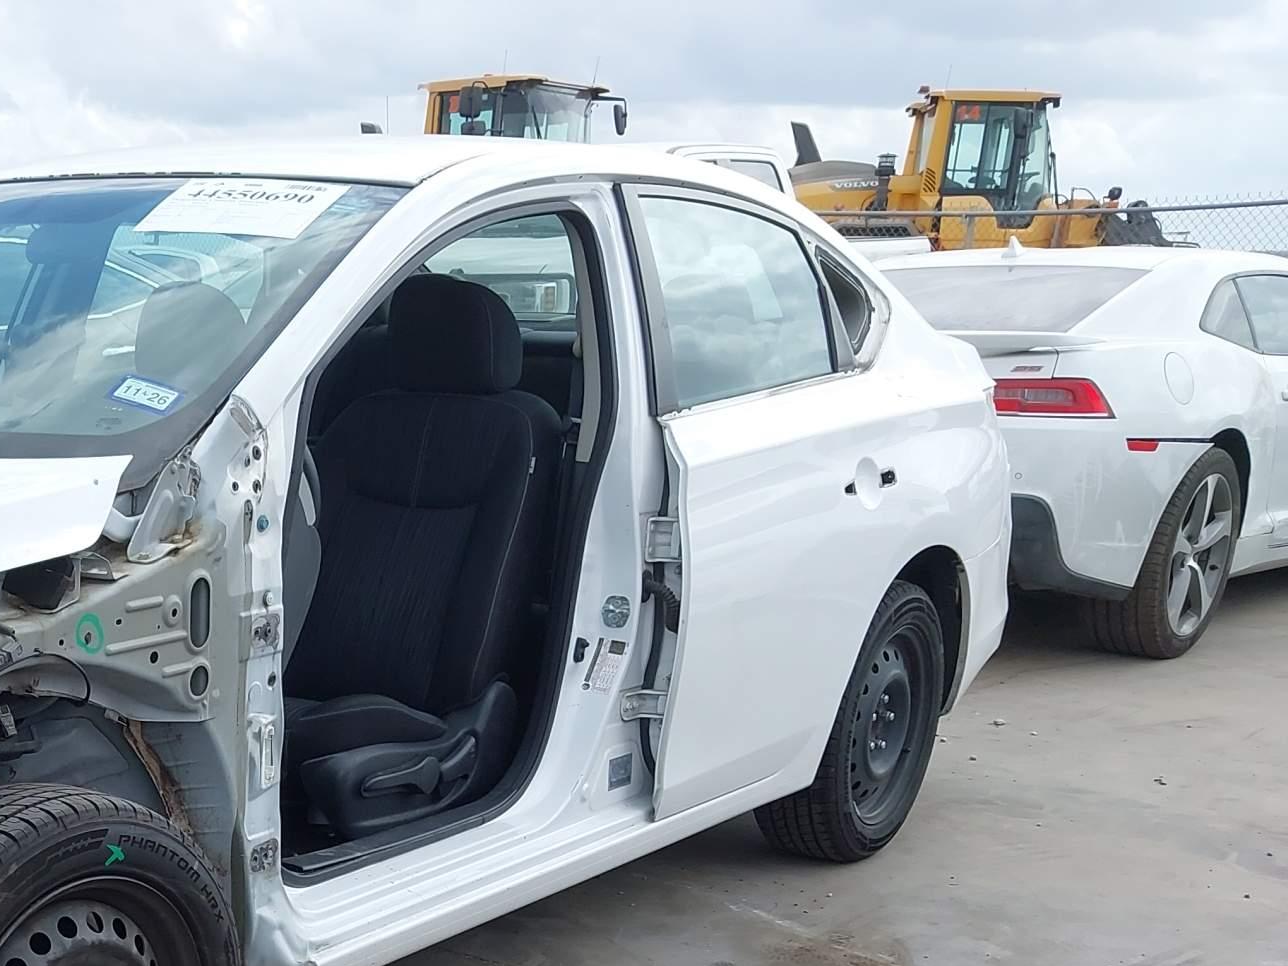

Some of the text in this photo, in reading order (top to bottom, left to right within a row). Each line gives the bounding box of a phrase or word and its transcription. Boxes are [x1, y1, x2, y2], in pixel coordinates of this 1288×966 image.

[834, 180, 879, 189] VOLVO
[188, 188, 315, 204] 44550690
[118, 834, 225, 924] PHANTOM HRX
